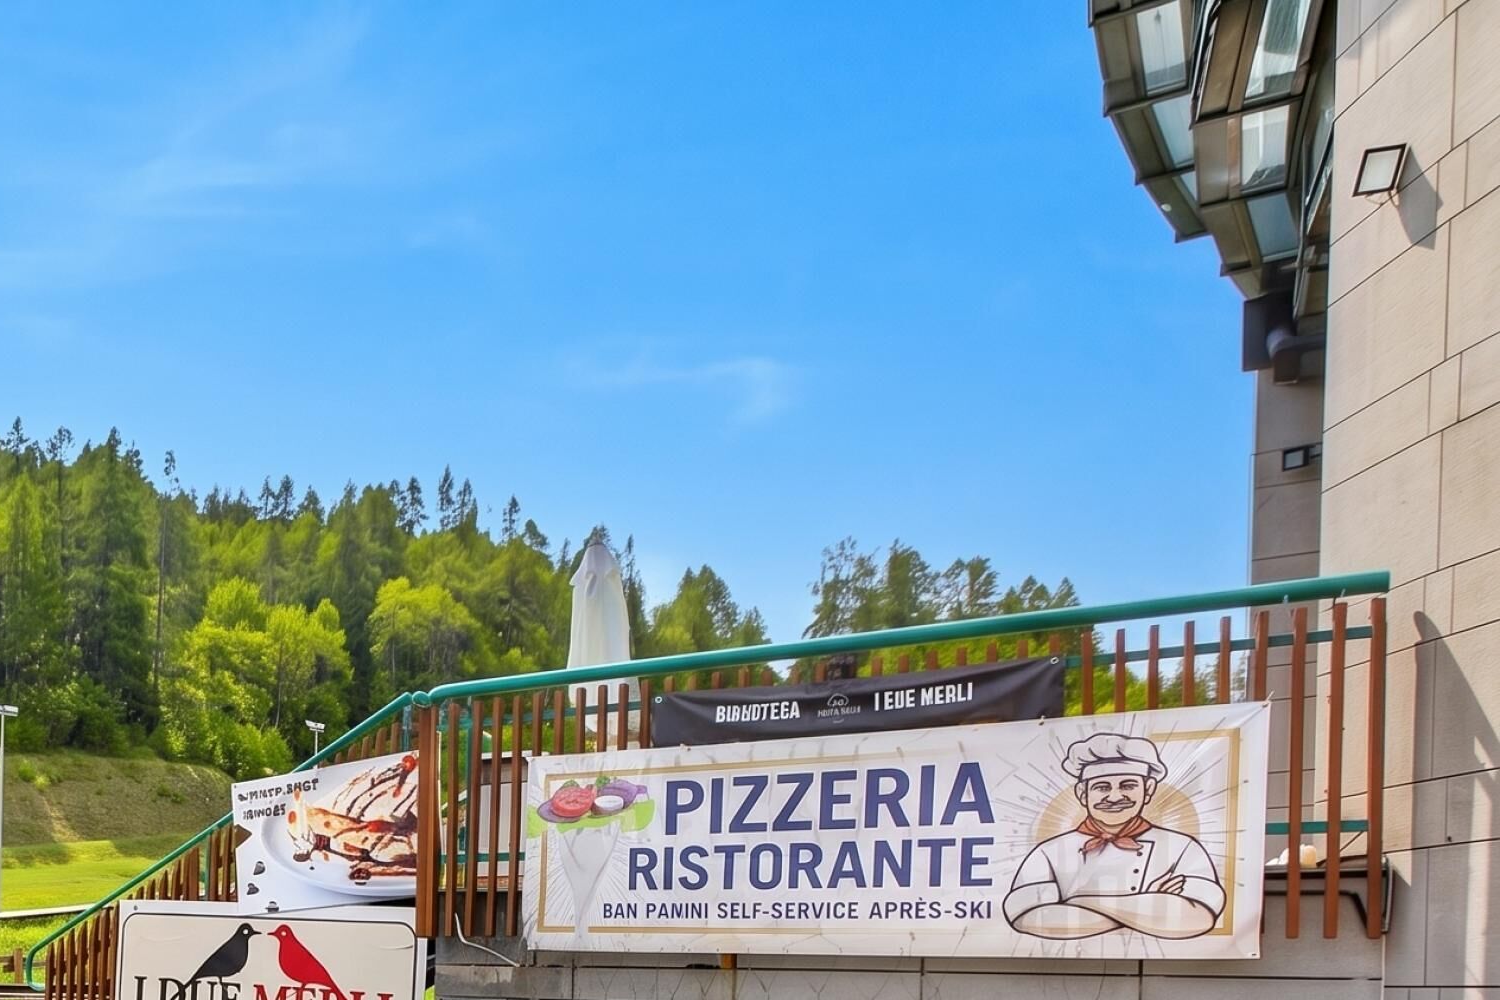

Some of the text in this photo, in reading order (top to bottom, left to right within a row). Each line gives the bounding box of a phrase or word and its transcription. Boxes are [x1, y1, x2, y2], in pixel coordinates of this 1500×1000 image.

[920, 682, 973, 706] MERLI
[664, 762, 996, 836] PIZZERIA
[628, 837, 995, 891] RISTORANTE
[603, 903, 637, 919] BAN
[716, 901, 859, 920] SELF-SERVICE
[868, 897, 993, 920] APRÈS-SKI
